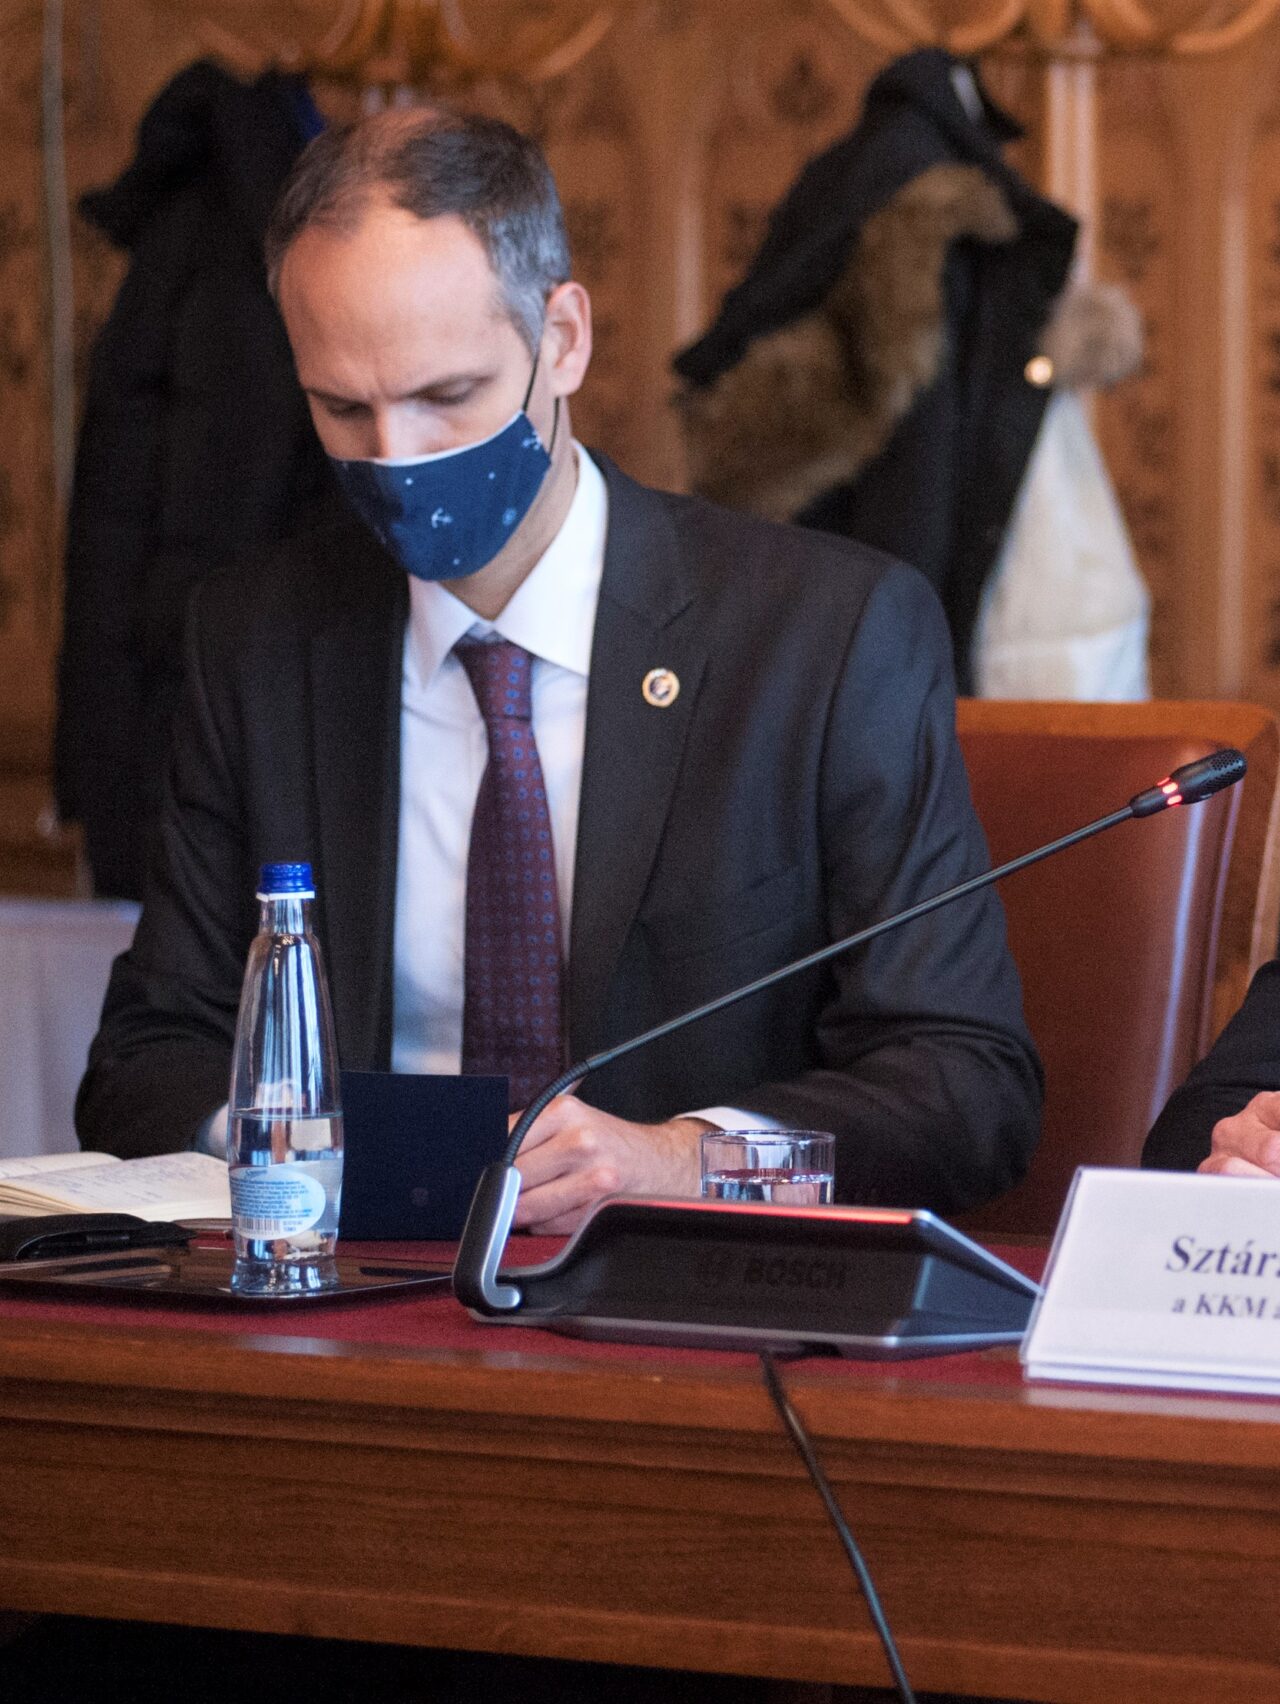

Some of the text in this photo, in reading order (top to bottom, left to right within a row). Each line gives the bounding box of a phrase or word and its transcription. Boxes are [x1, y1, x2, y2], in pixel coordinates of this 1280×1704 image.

[743, 1257, 847, 1291] BOSCH
[1171, 1297, 1186, 1315] a
[1194, 1293, 1267, 1319] KKM
